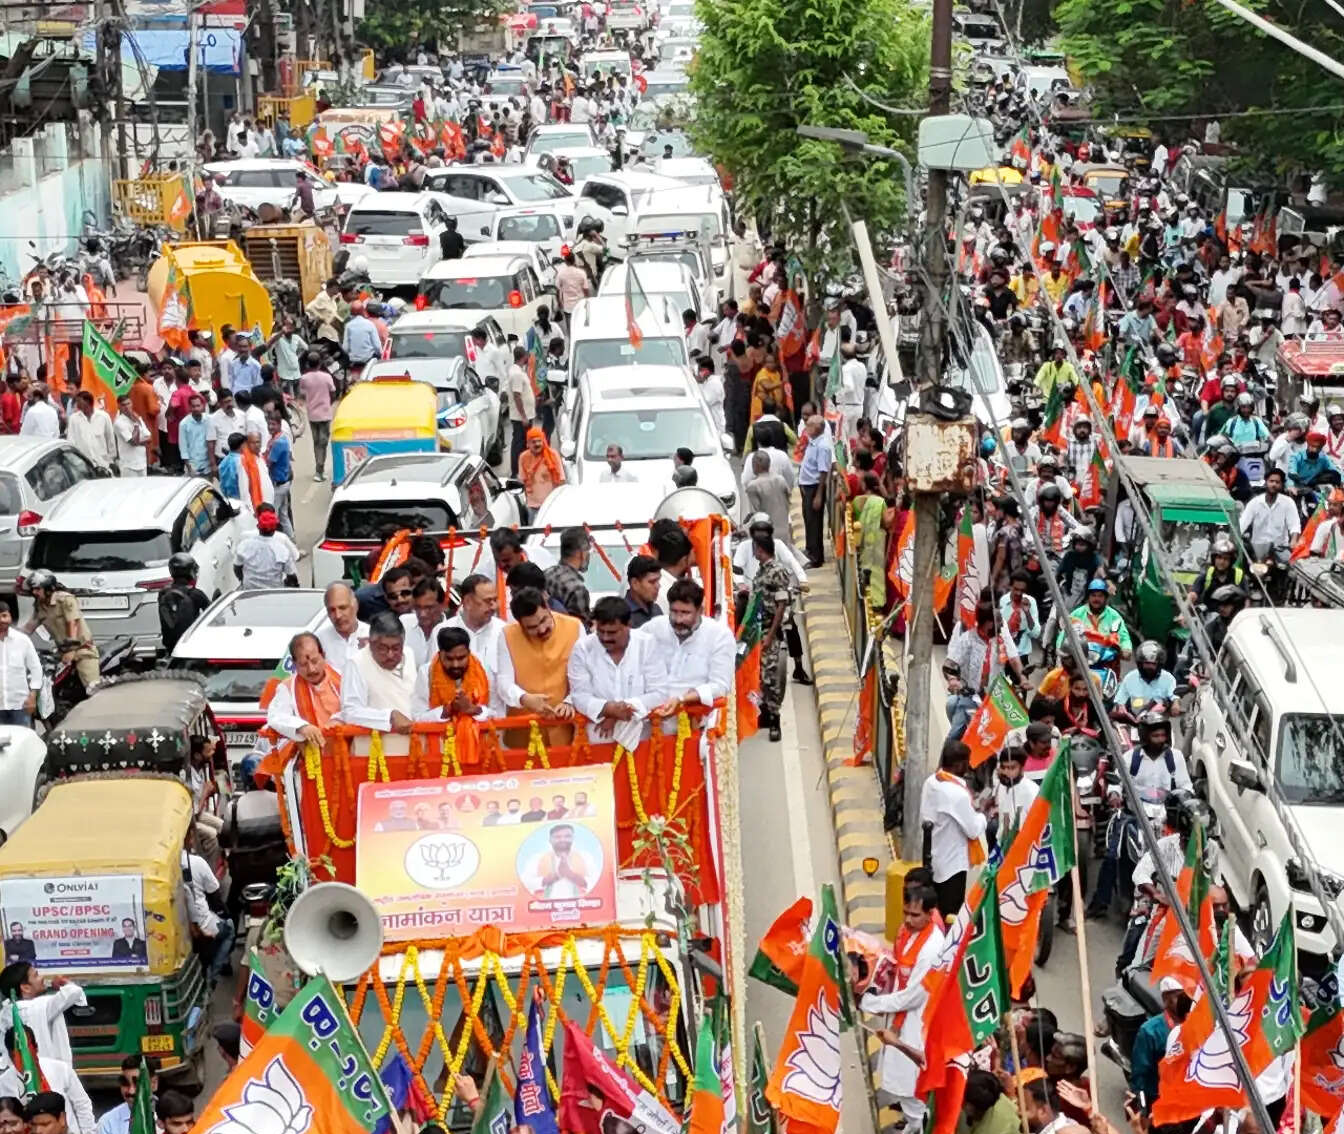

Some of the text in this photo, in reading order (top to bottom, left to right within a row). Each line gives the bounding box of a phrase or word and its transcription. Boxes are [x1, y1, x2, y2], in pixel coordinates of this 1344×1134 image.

[32, 905, 111, 917] UPSC/BPSC
[380, 906, 513, 929] नामांकन यात्रा
[32, 927, 116, 941] GRAND OPENING
